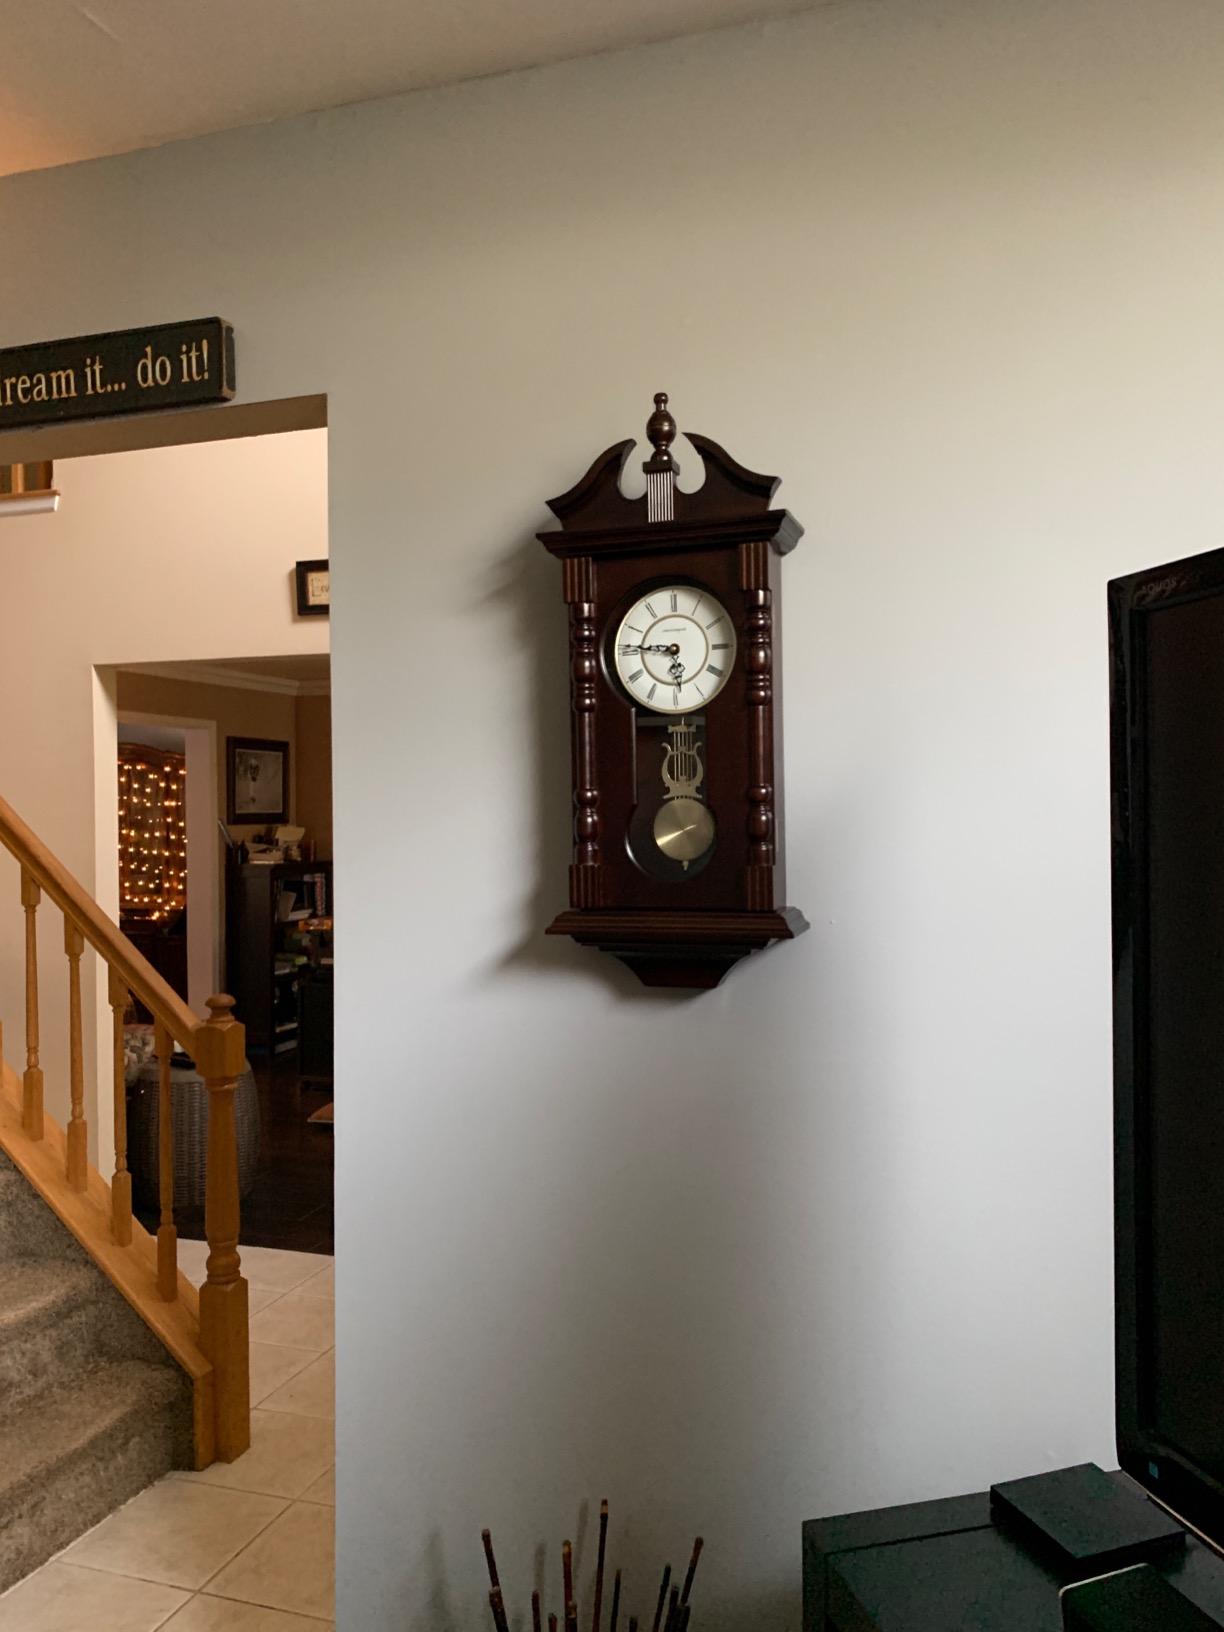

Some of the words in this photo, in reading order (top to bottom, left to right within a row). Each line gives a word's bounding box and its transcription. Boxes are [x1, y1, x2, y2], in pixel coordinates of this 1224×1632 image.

[0, 368, 77, 407] ream
[85, 356, 126, 396] it...
[137, 345, 172, 389] do
[180, 339, 210, 383] it!
